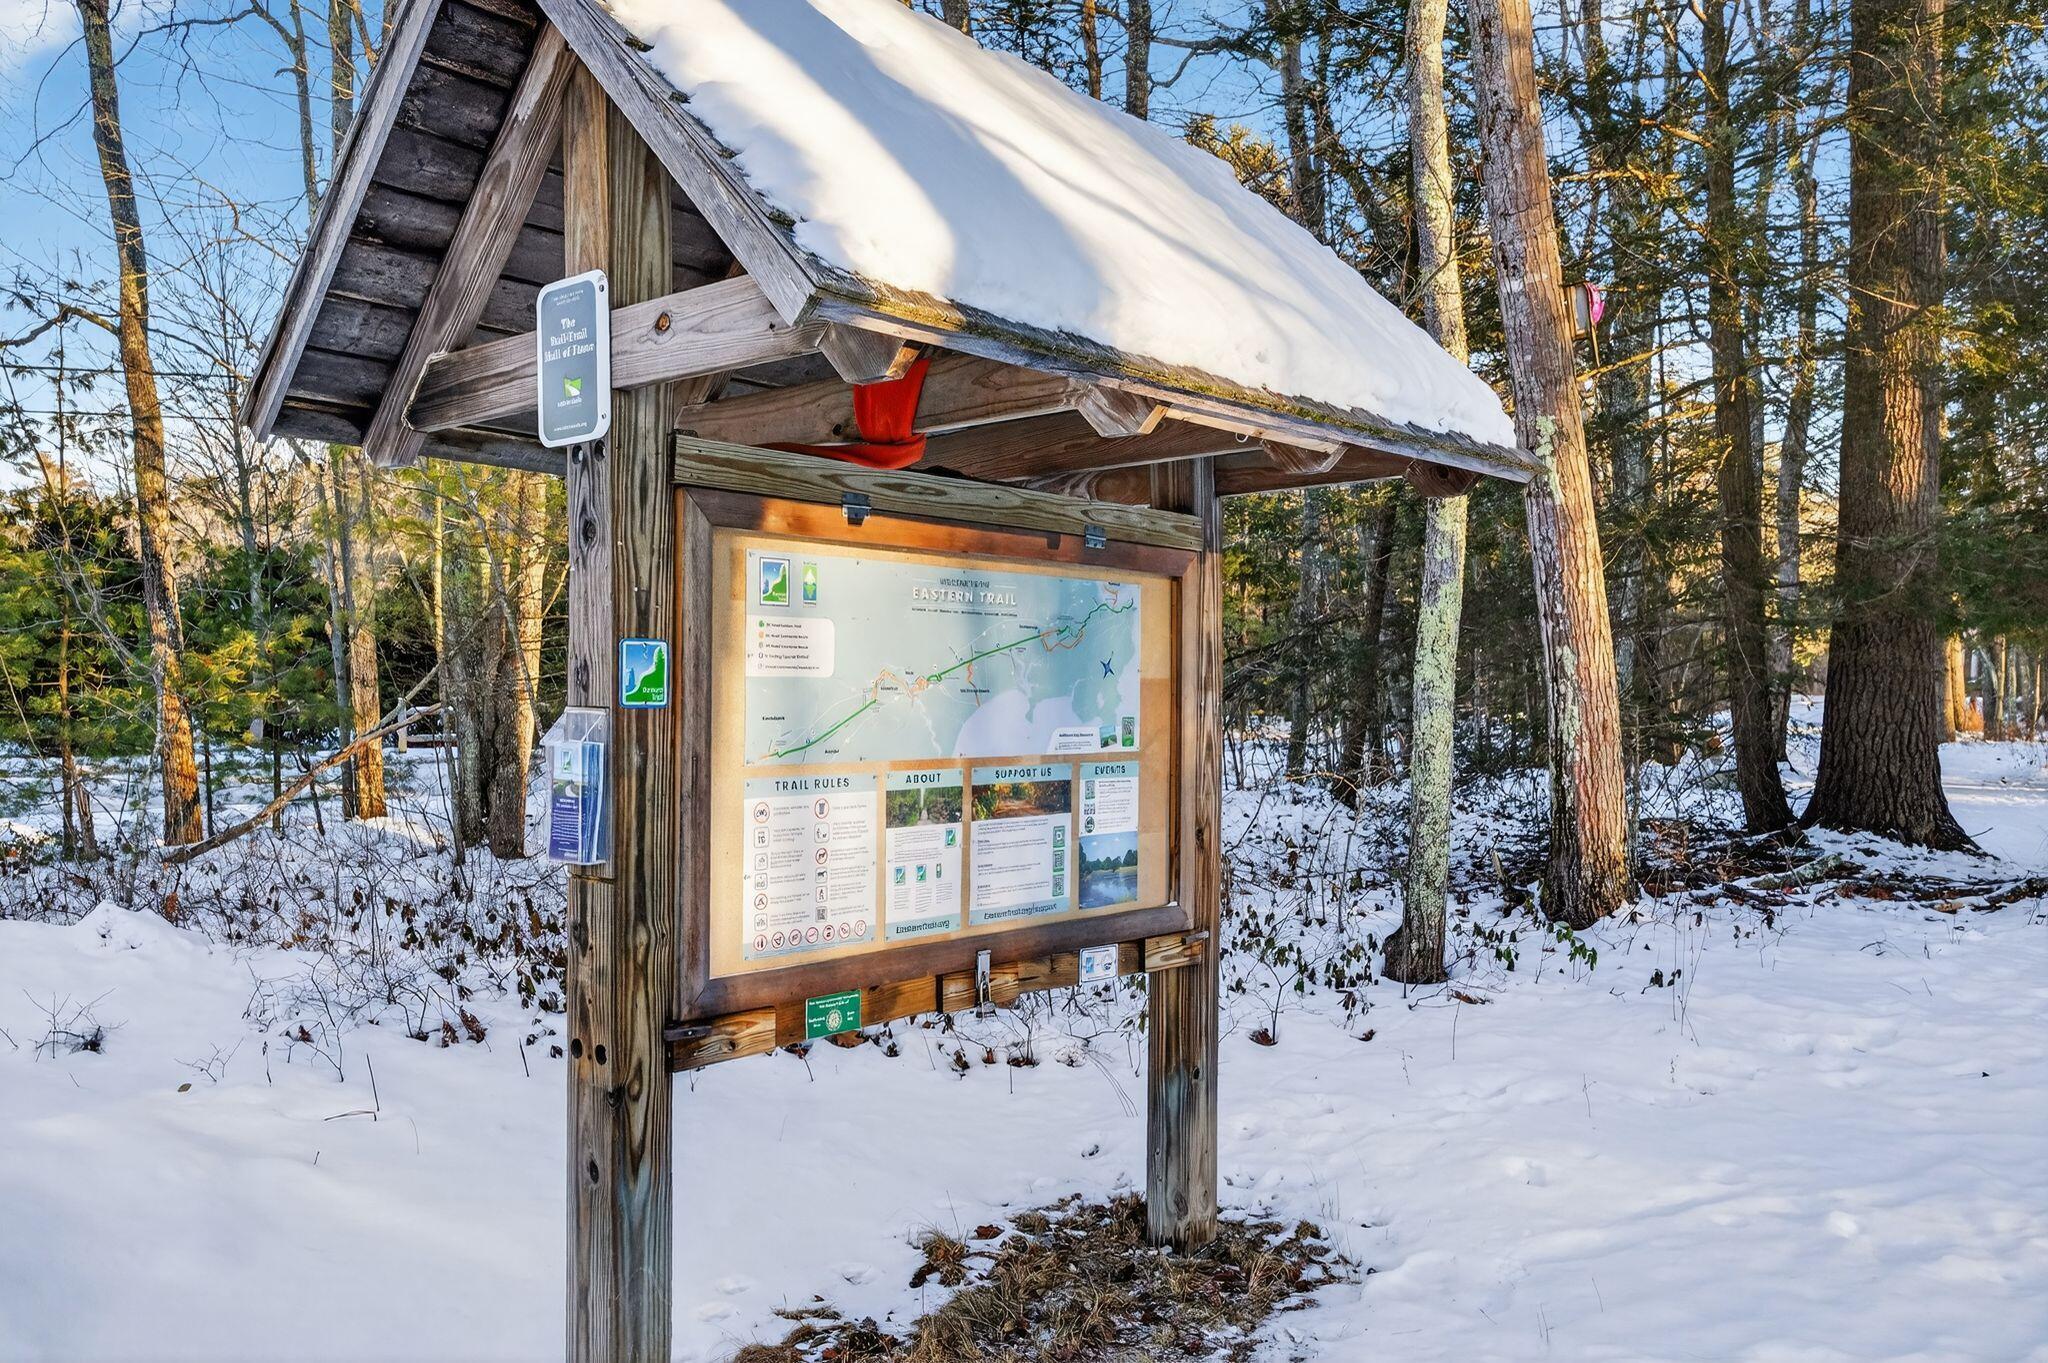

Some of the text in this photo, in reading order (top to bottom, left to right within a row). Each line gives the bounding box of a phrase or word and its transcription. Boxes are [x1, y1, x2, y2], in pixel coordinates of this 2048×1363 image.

[560, 317, 576, 330] The
[912, 586, 1018, 606] EASTERN TRAIL
[995, 767, 1052, 779] SUPPORT US
[1094, 764, 1126, 776] EVENTS
[775, 777, 850, 792] TRAIL RULES
[905, 773, 942, 784] ABOUT
